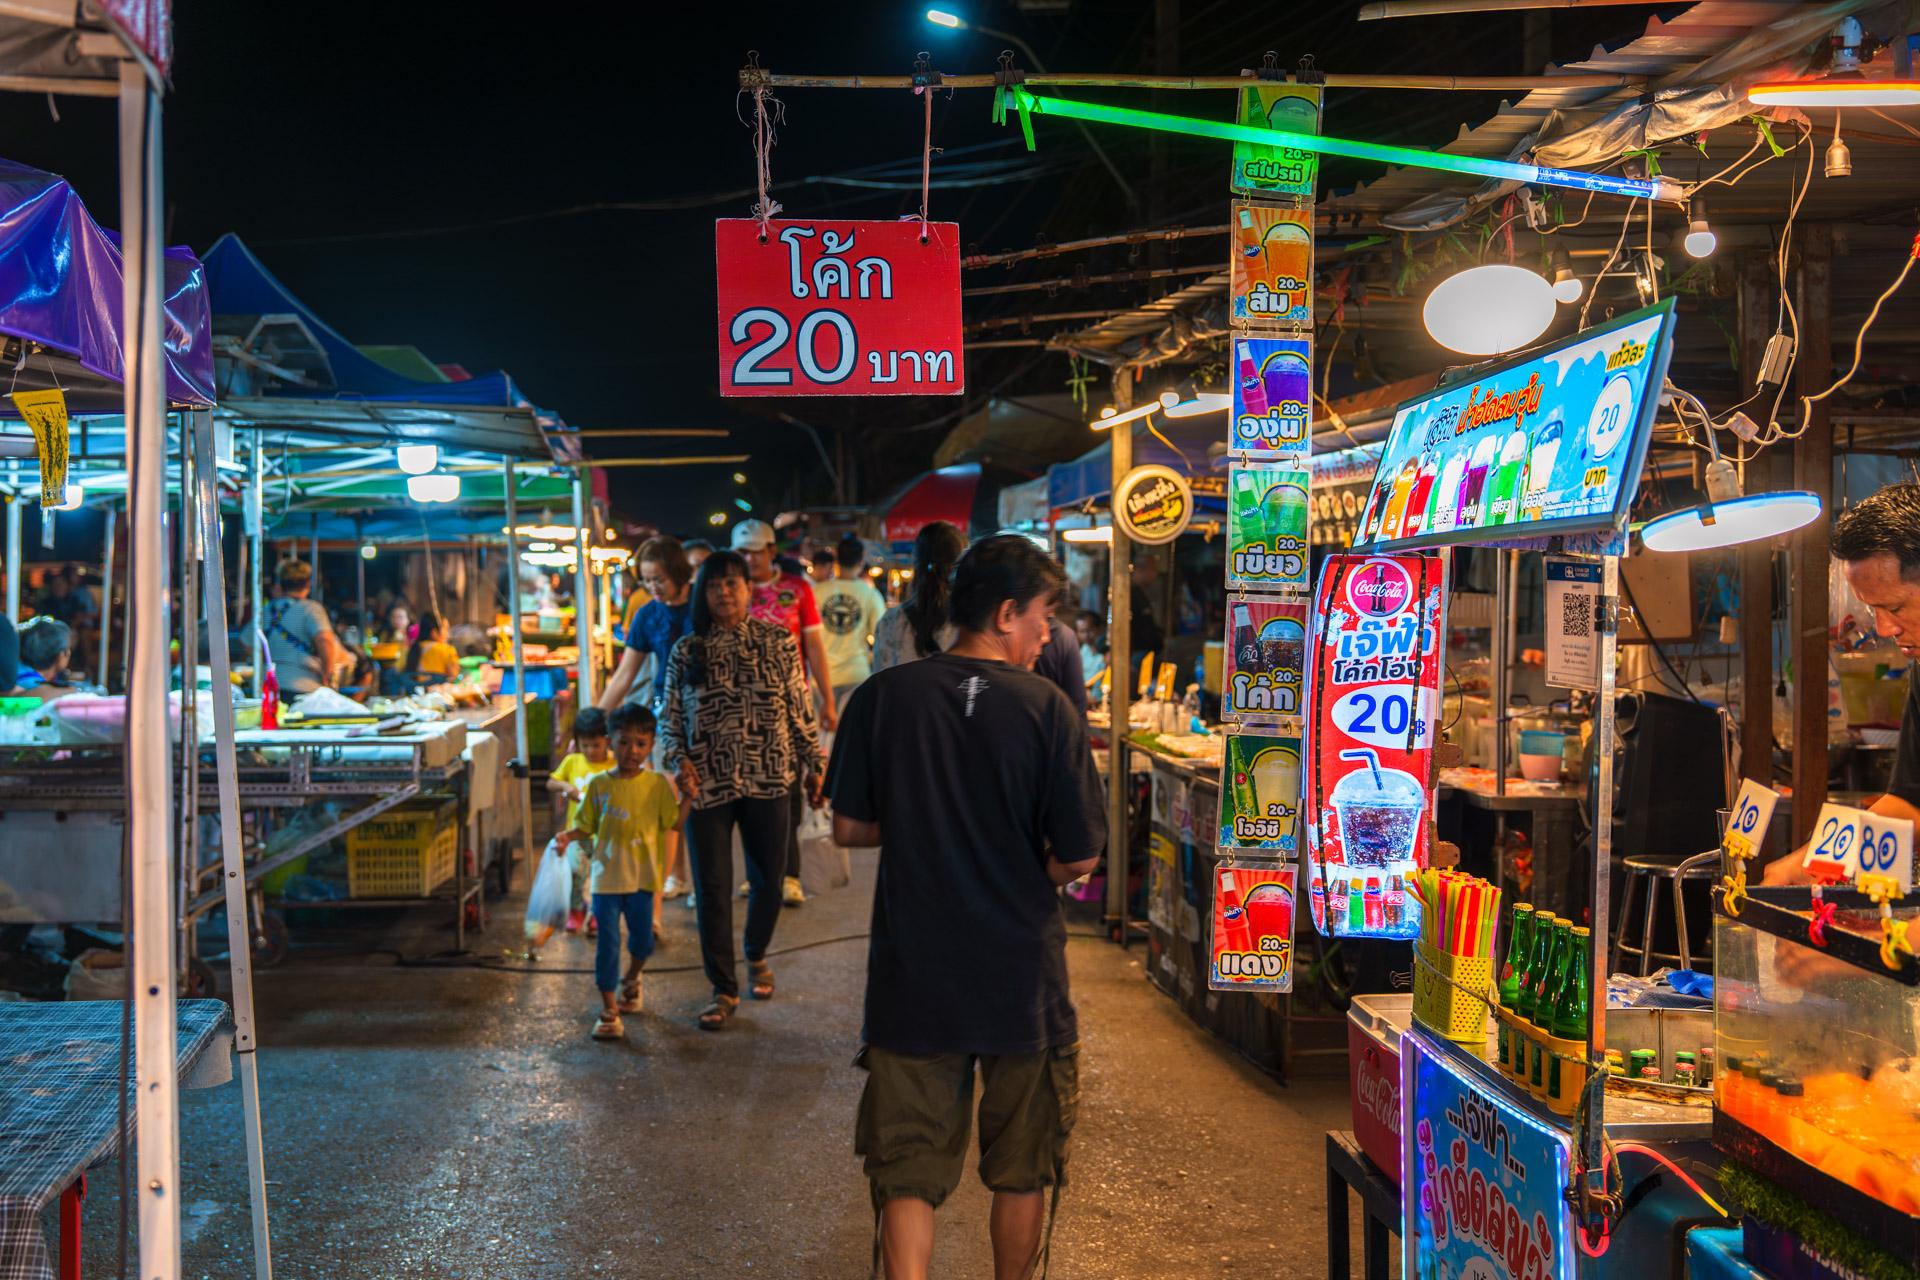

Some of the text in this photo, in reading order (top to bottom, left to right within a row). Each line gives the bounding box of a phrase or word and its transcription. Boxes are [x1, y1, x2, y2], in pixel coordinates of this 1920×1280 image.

[779, 225, 892, 299] โค้ก
[1249, 284, 1289, 312] ส้ม
[1278, 278, 1305, 290] 20.-
[729, 306, 955, 386] 20 บาท
[1605, 340, 1647, 371] แก้วละ
[1282, 404, 1308, 416] 20.-
[1596, 403, 1620, 435] 20
[1240, 410, 1299, 446] องุ่น
[1584, 466, 1607, 488] บาท
[1279, 538, 1305, 550] 20.-
[1236, 545, 1302, 576] เขียว
[1275, 671, 1301, 683] 20.-
[1233, 674, 1295, 711] โค้ก
[1268, 803, 1296, 816] 20.-
[1732, 794, 1759, 833] 10
[1236, 817, 1280, 837] โออิชิ
[1815, 817, 1855, 860] 20
[1859, 825, 1897, 871] 80
[1261, 938, 1289, 951] 20.-
[1221, 953, 1282, 977] แดง
